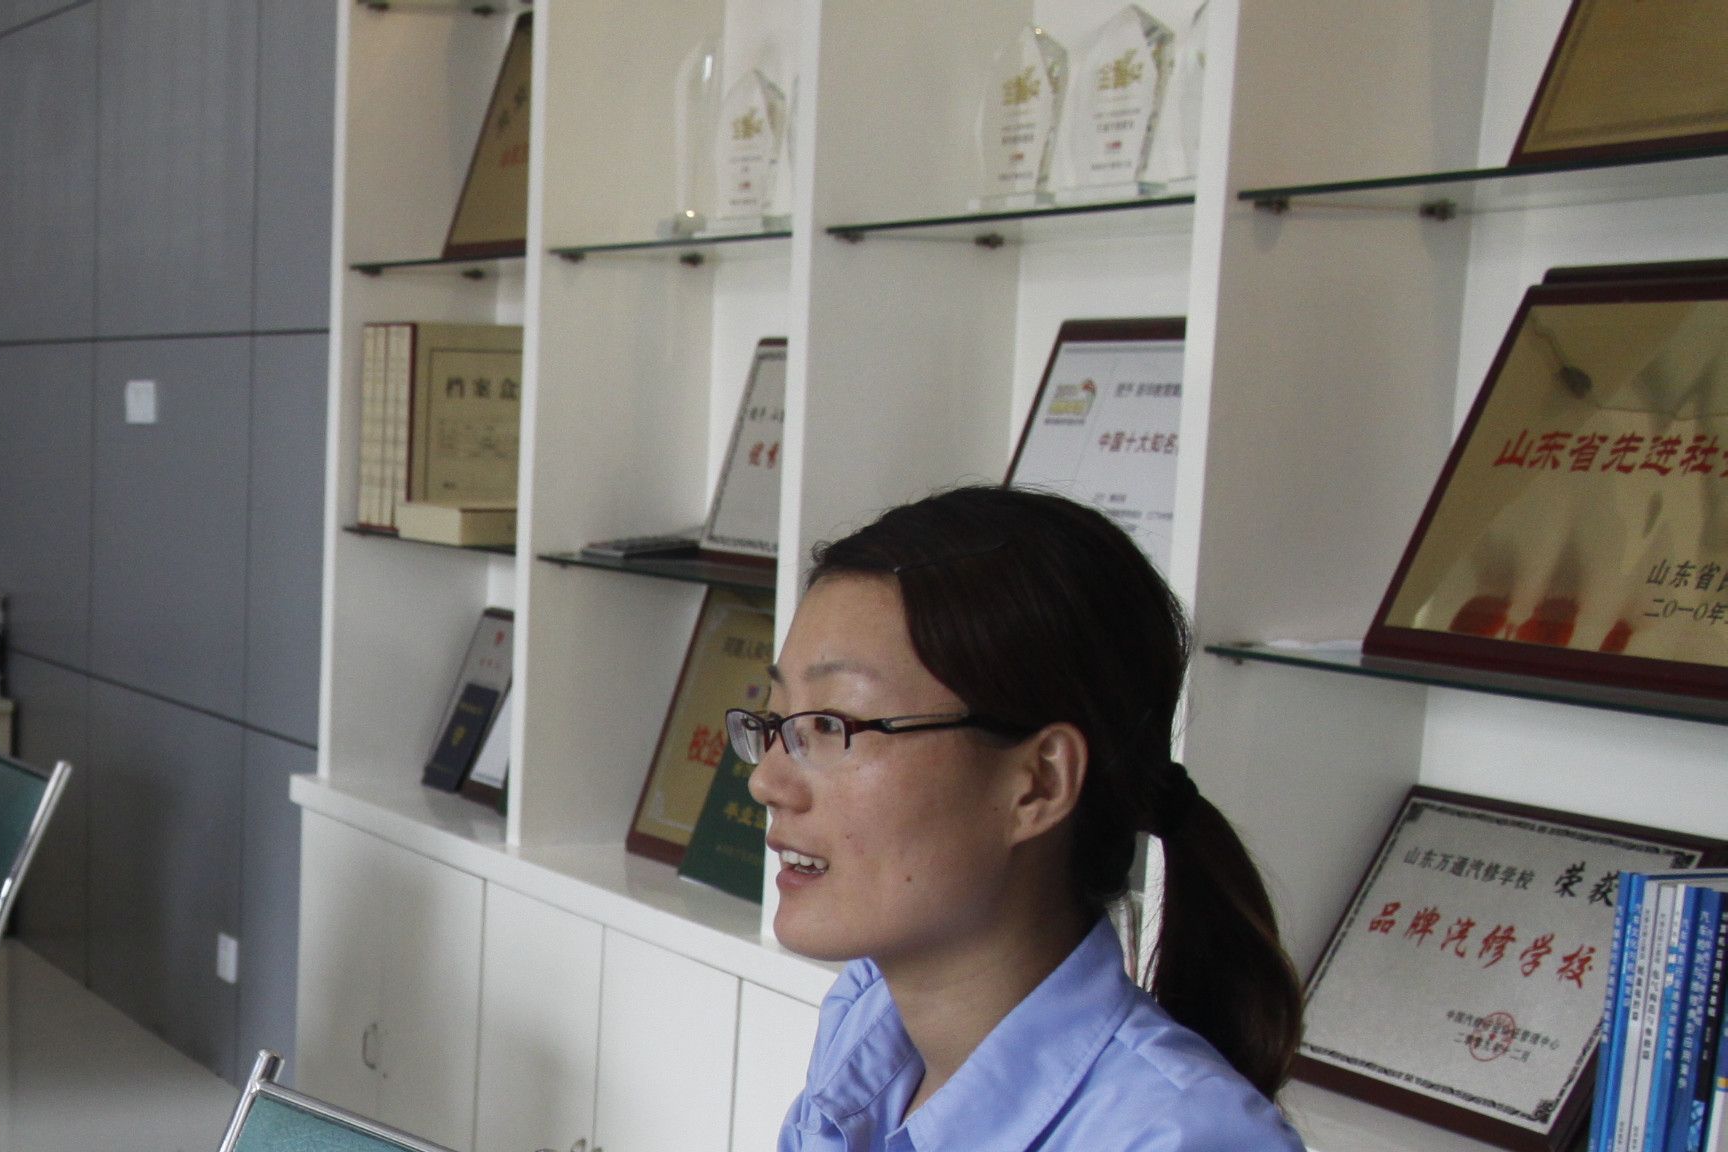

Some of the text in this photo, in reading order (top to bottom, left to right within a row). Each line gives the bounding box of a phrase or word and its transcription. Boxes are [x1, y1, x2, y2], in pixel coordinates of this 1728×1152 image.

[1492, 428, 1728, 478] 山东省先进社
[1403, 848, 1621, 906] 山东万通汽修学校 荣获
[1368, 902, 1597, 988] 品牌汽修学校
